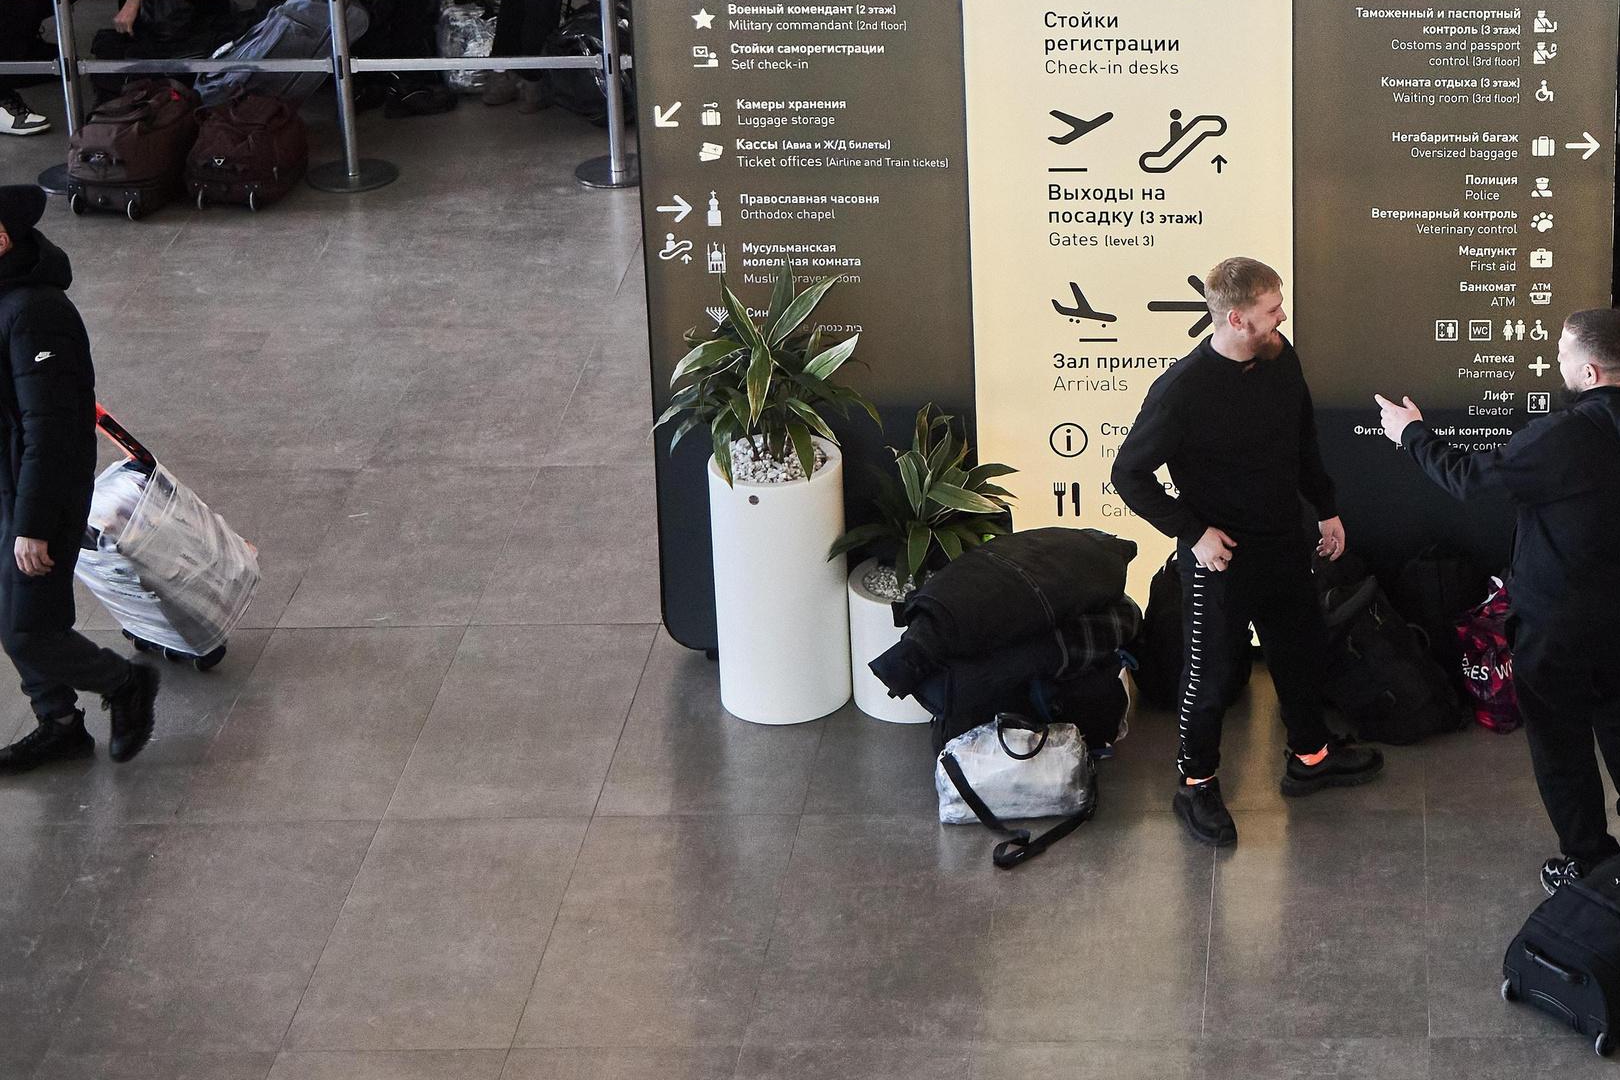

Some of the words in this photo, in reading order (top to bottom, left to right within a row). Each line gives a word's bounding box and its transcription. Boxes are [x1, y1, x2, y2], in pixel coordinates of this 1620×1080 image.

[728, 4, 784, 14] Военный
[788, 5, 853, 15] комендант
[868, 5, 896, 14] этаж)
[1356, 7, 1433, 18] Таможенный
[1447, 8, 1520, 21] паспортный
[729, 20, 773, 32] Military
[776, 20, 853, 30] commandant
[857, 21, 877, 30] (2nd
[881, 21, 906, 30] floor)
[1045, 12, 1118, 28] Стойки
[1423, 25, 1478, 36] контроль
[1493, 25, 1520, 35] этаж)
[731, 43, 774, 53] Стойки
[778, 44, 885, 55] саморегистрации
[1045, 39, 1178, 55] регистрации
[1445, 40, 1467, 50] and
[1470, 41, 1520, 52] passport
[732, 59, 754, 70] Self
[758, 59, 808, 70] check-in
[1046, 60, 1122, 74] Check-in
[1129, 61, 1178, 74] desks
[1428, 56, 1469, 66] control
[1472, 56, 1492, 66] (3rd
[1494, 56, 1521, 66] floor)
[1382, 77, 1430, 87] Комната
[1435, 79, 1477, 88] отдыха
[1493, 78, 1520, 88] этаж)
[737, 99, 784, 111] Камеры
[789, 101, 846, 111] хранения
[1393, 93, 1434, 105] Waiting
[1473, 93, 1491, 103] (3rd
[1495, 93, 1520, 103] floor)
[738, 115, 787, 127] Luggage
[792, 116, 834, 127] storage
[1392, 131, 1479, 144] Негабаритный
[1483, 131, 1518, 143] багаж
[737, 139, 777, 150] Кассы
[783, 140, 811, 150] (Авиа
[824, 140, 846, 150] Ж/Д
[849, 140, 890, 150] билеты)
[1411, 148, 1465, 158] Oversized
[1469, 148, 1517, 160] baggage
[737, 156, 776, 167] Ticket
[780, 156, 822, 166] offices
[826, 157, 861, 167] (Airline
[864, 158, 882, 166] and
[885, 158, 909, 166] Train
[913, 158, 949, 168] tickets)
[1466, 175, 1518, 186] Полиция
[1049, 184, 1133, 203] Выходы
[1142, 189, 1164, 200] на
[1466, 190, 1499, 200] Police
[740, 194, 827, 206] Православная
[831, 195, 879, 203] часовня
[741, 209, 793, 219] Orthodox
[797, 209, 835, 221] chapel
[1049, 211, 1133, 227] посадку
[1141, 211, 1154, 224] (3
[1160, 211, 1202, 224] этаж)
[1372, 208, 1459, 220] Ветеринарный
[1464, 210, 1518, 220] контроль
[1417, 224, 1474, 236] Veterinary
[1477, 224, 1517, 234] control
[1050, 232, 1098, 246] Gates
[1105, 235, 1138, 246] (level
[1143, 235, 1153, 246] 3)
[742, 243, 836, 255] Мусульманская
[1459, 246, 1517, 258] Медпункт
[813, 258, 861, 266] комната
[1471, 261, 1496, 271] First
[1500, 261, 1515, 271] aid
[1460, 282, 1516, 292] Банкомат
[1532, 282, 1551, 290] ATM
[1491, 297, 1515, 306] ATM
[1472, 326, 1488, 336] WC
[1054, 353, 1088, 368] Зал
[1097, 355, 1179, 372] прилета
[1474, 353, 1514, 363] Аптека
[1459, 368, 1514, 380] Pharmacy
[1054, 376, 1127, 391] Arrivals
[1483, 391, 1514, 402] Лифт
[1469, 406, 1513, 415] Elevator
[1459, 427, 1512, 437] контроль
